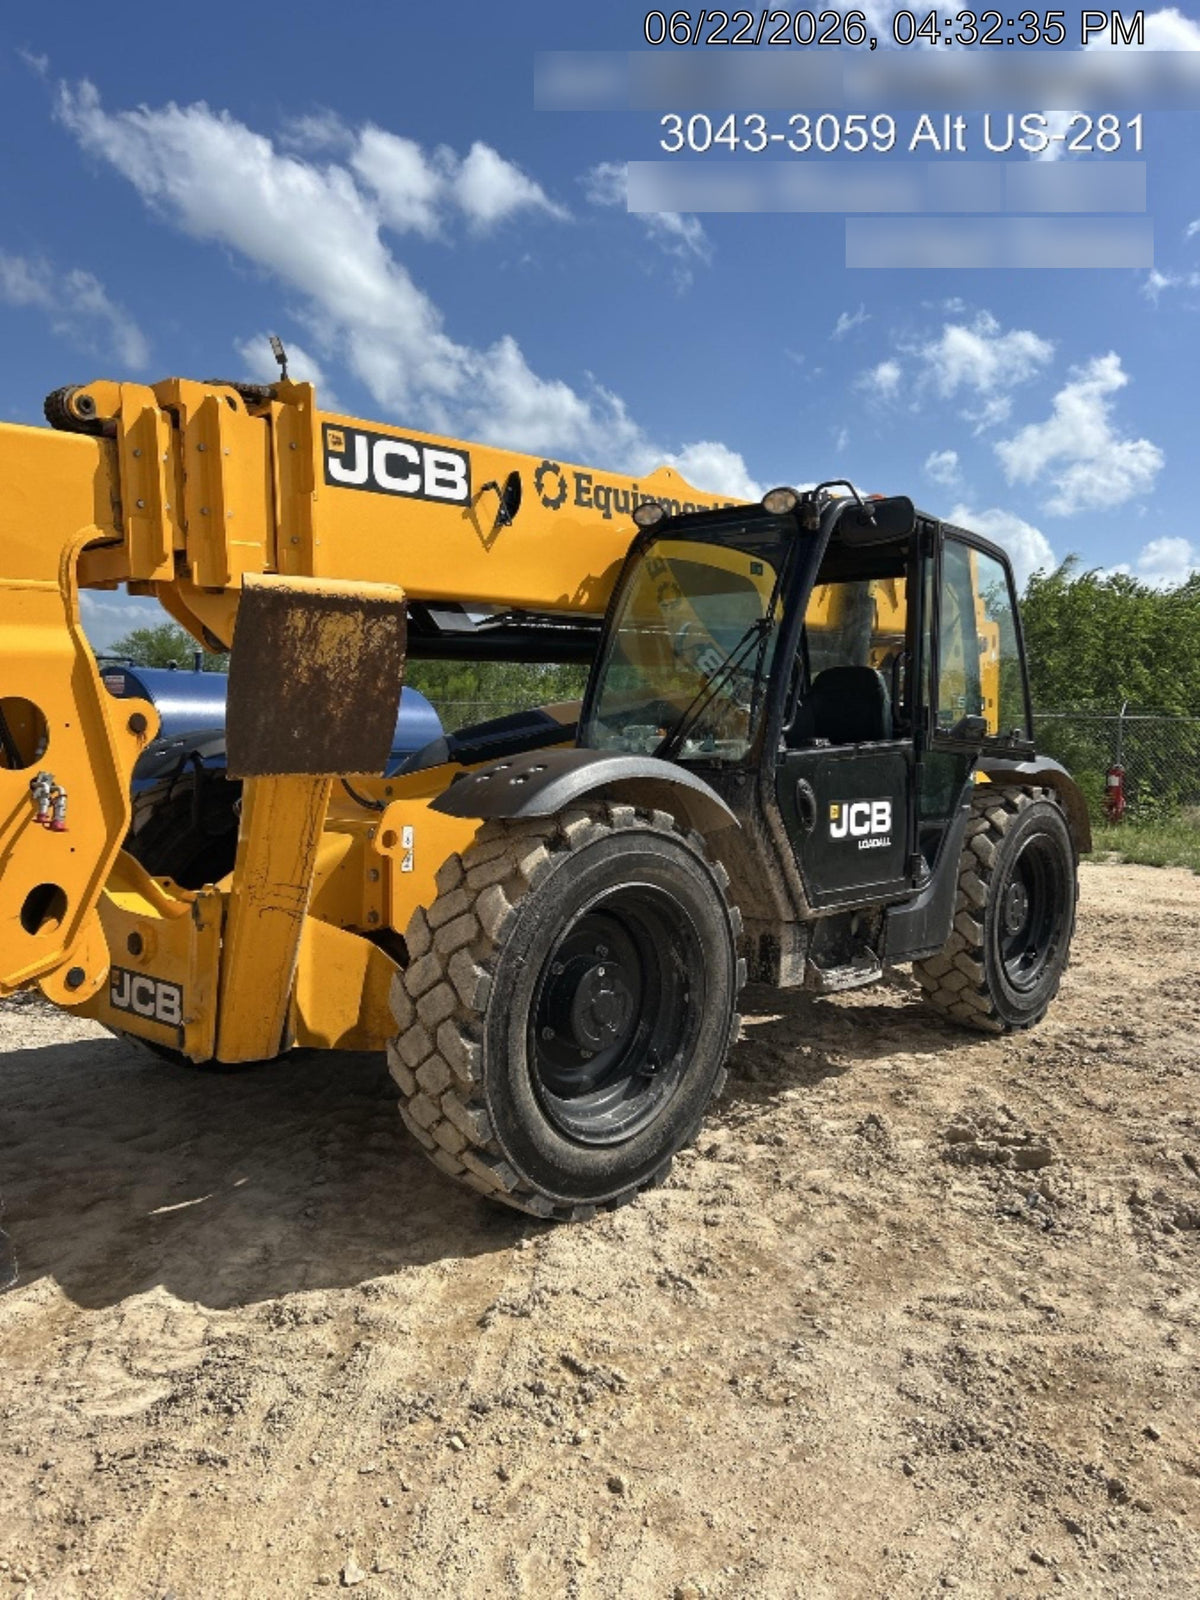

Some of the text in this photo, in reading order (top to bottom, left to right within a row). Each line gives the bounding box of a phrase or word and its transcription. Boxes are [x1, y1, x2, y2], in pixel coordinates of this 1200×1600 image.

[328, 434, 468, 501] JCB
[829, 801, 892, 838] JCB
[111, 972, 182, 1025] JCB
